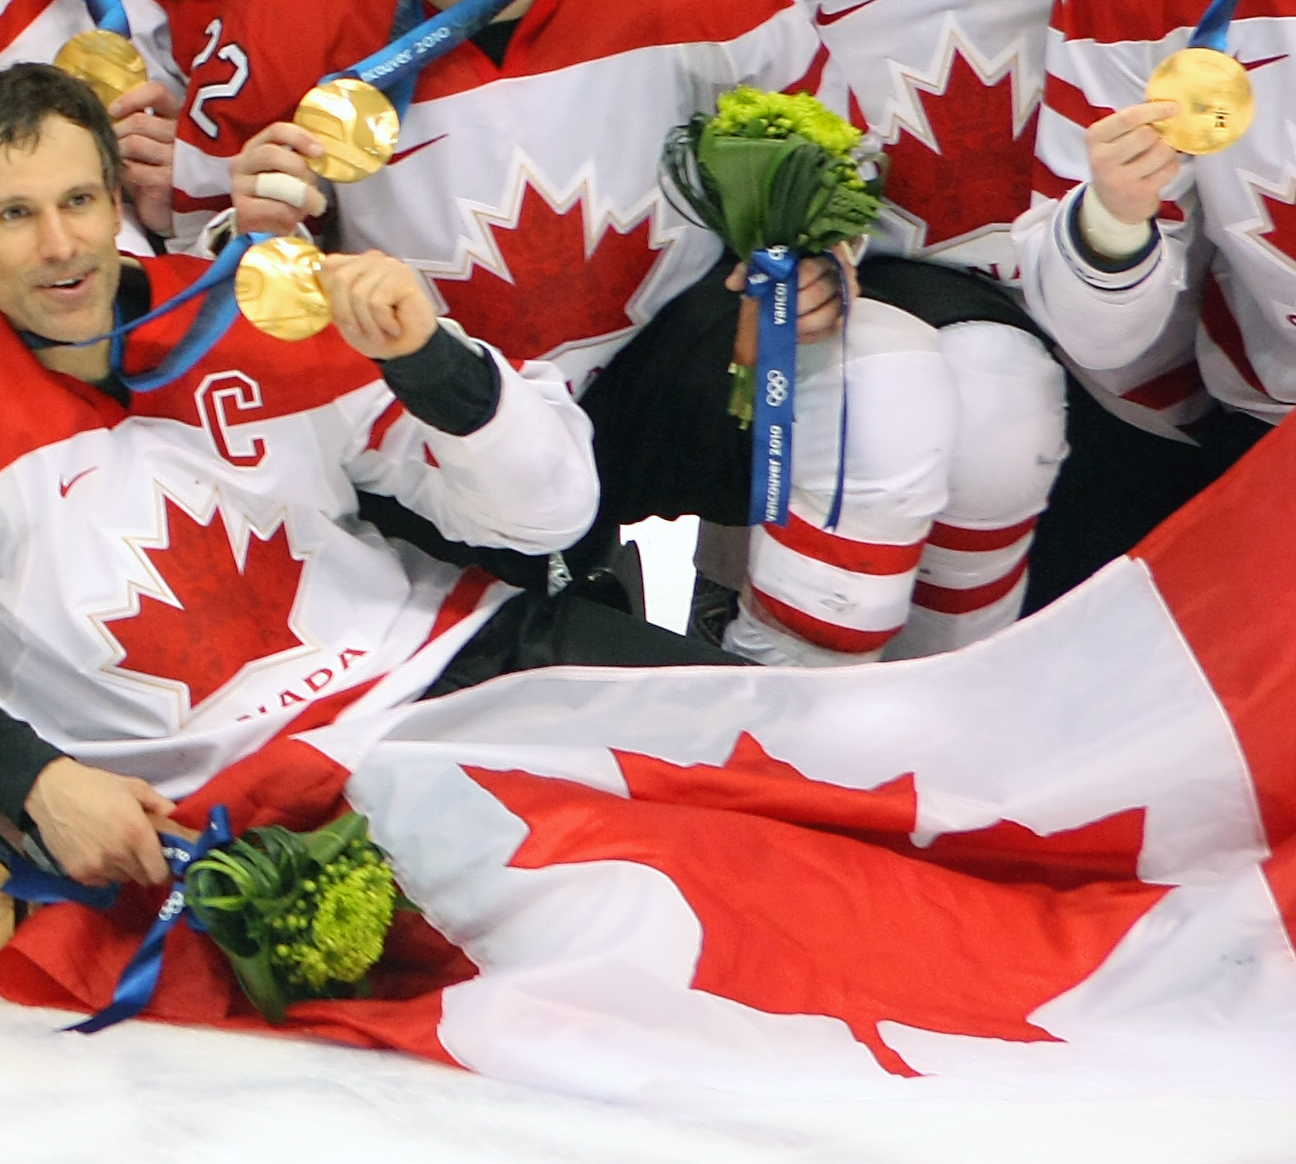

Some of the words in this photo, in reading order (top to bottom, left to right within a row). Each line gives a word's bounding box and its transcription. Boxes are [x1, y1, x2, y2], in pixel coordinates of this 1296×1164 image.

[416, 26, 452, 55] 2010
[194, 370, 270, 471] C
[769, 424, 783, 457] 2010
[764, 459, 783, 523] vancouver
